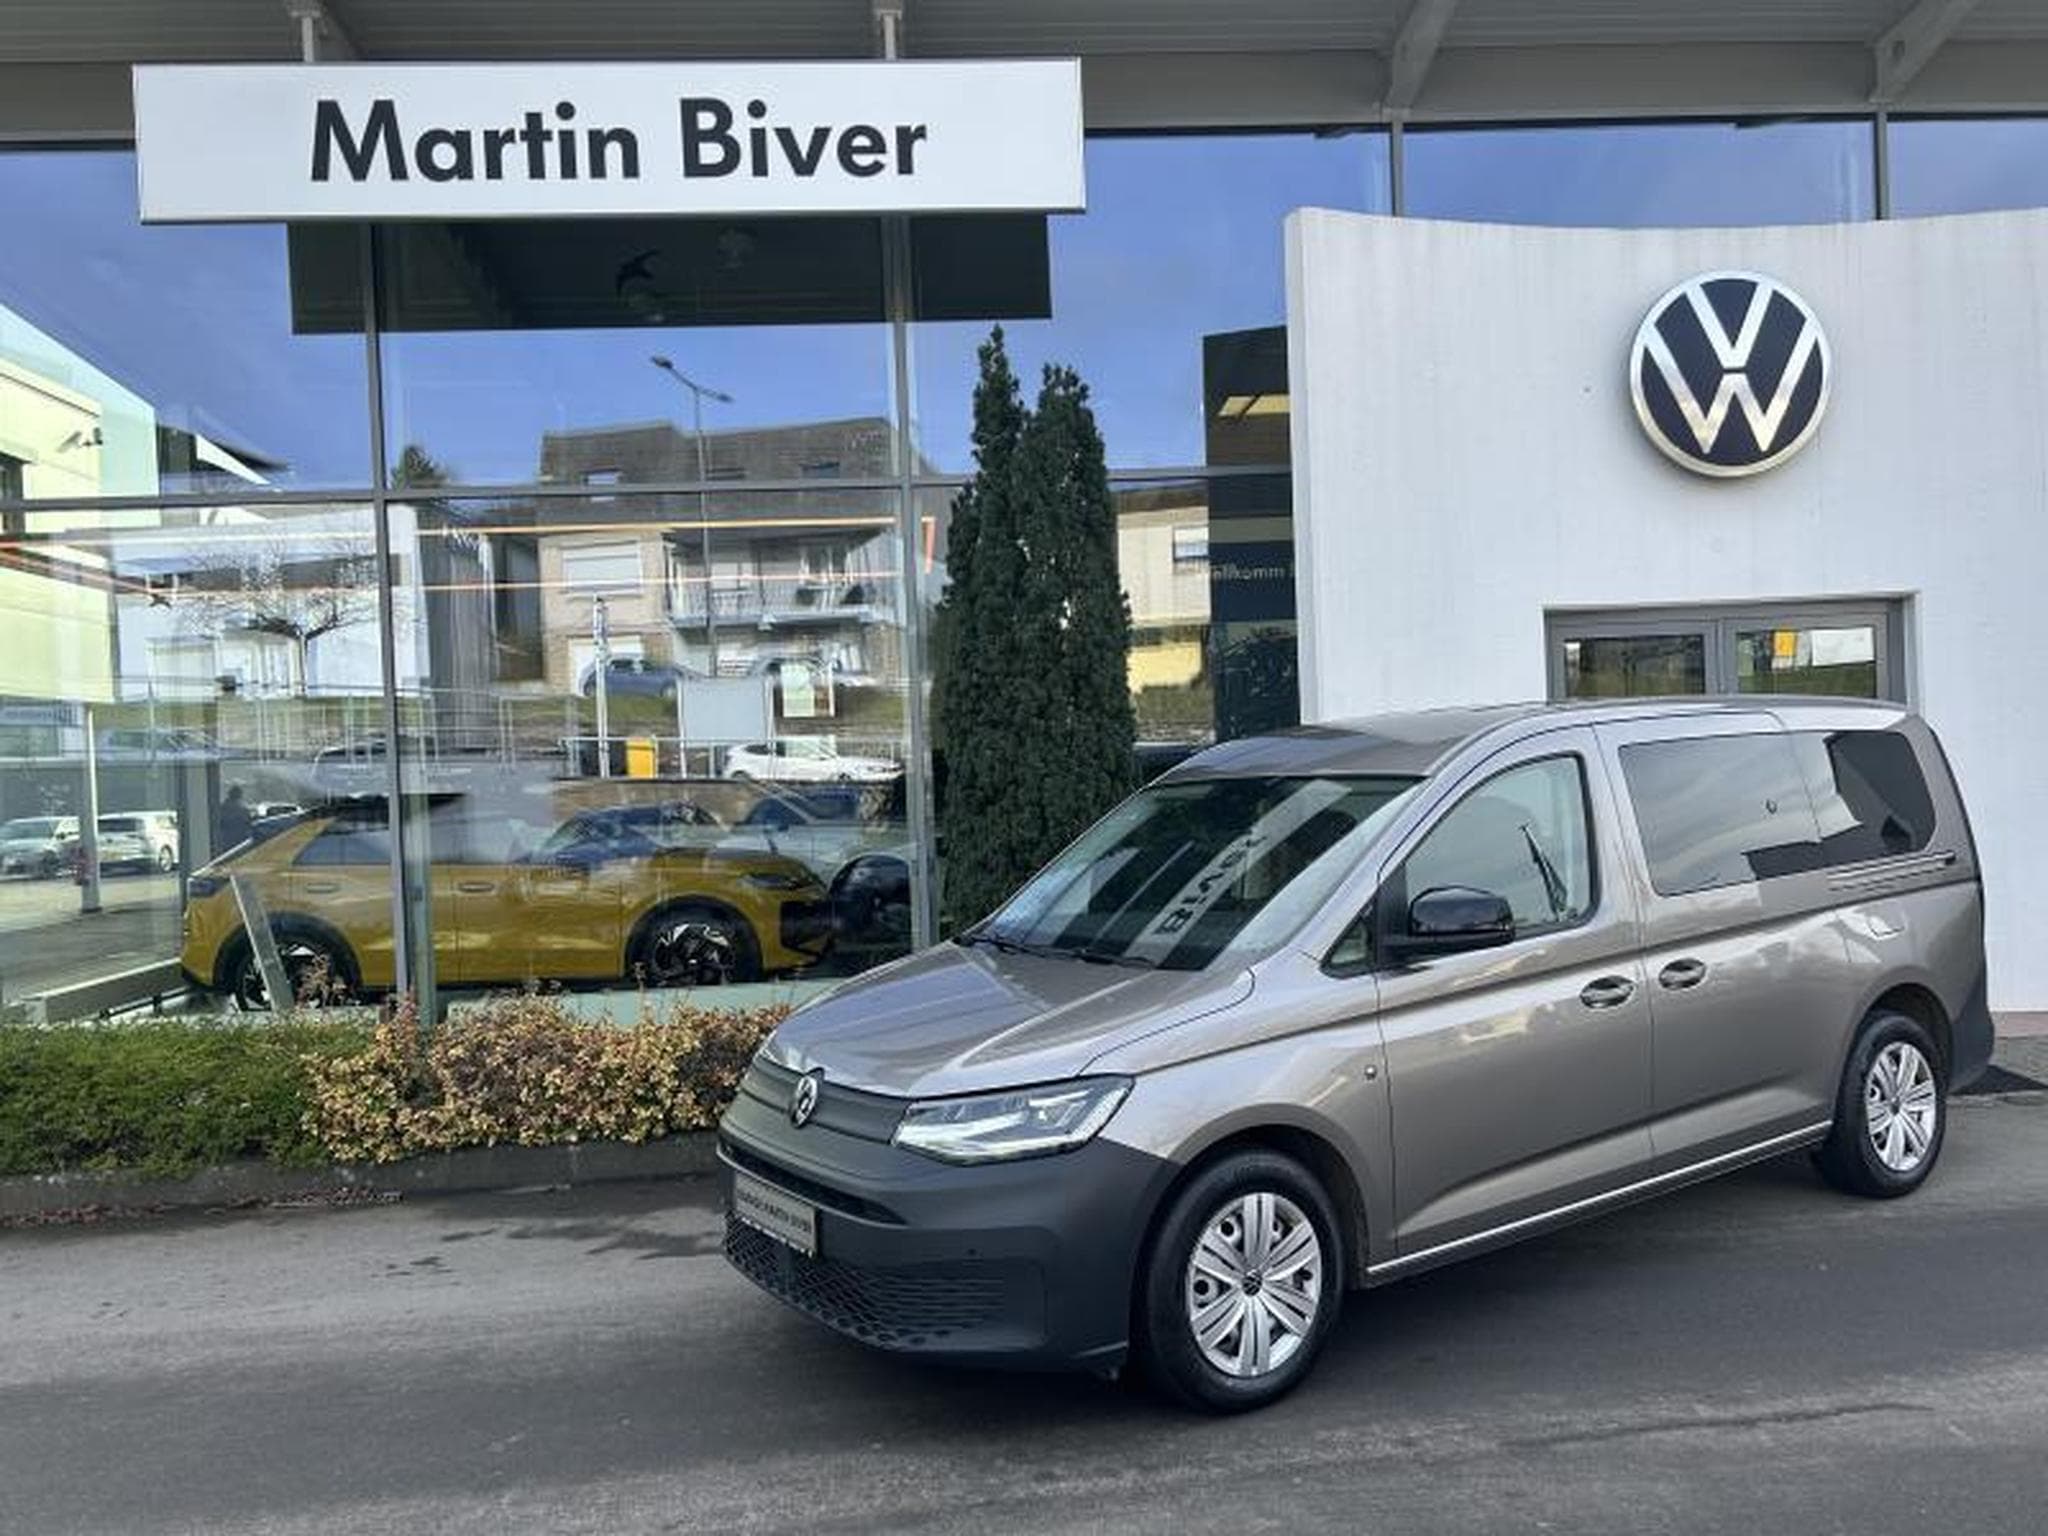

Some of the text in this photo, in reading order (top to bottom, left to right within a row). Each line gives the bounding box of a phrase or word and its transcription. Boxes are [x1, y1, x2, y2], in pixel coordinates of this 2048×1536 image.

[310, 96, 927, 182] Martin Biver
[1634, 274, 1826, 462] VW
